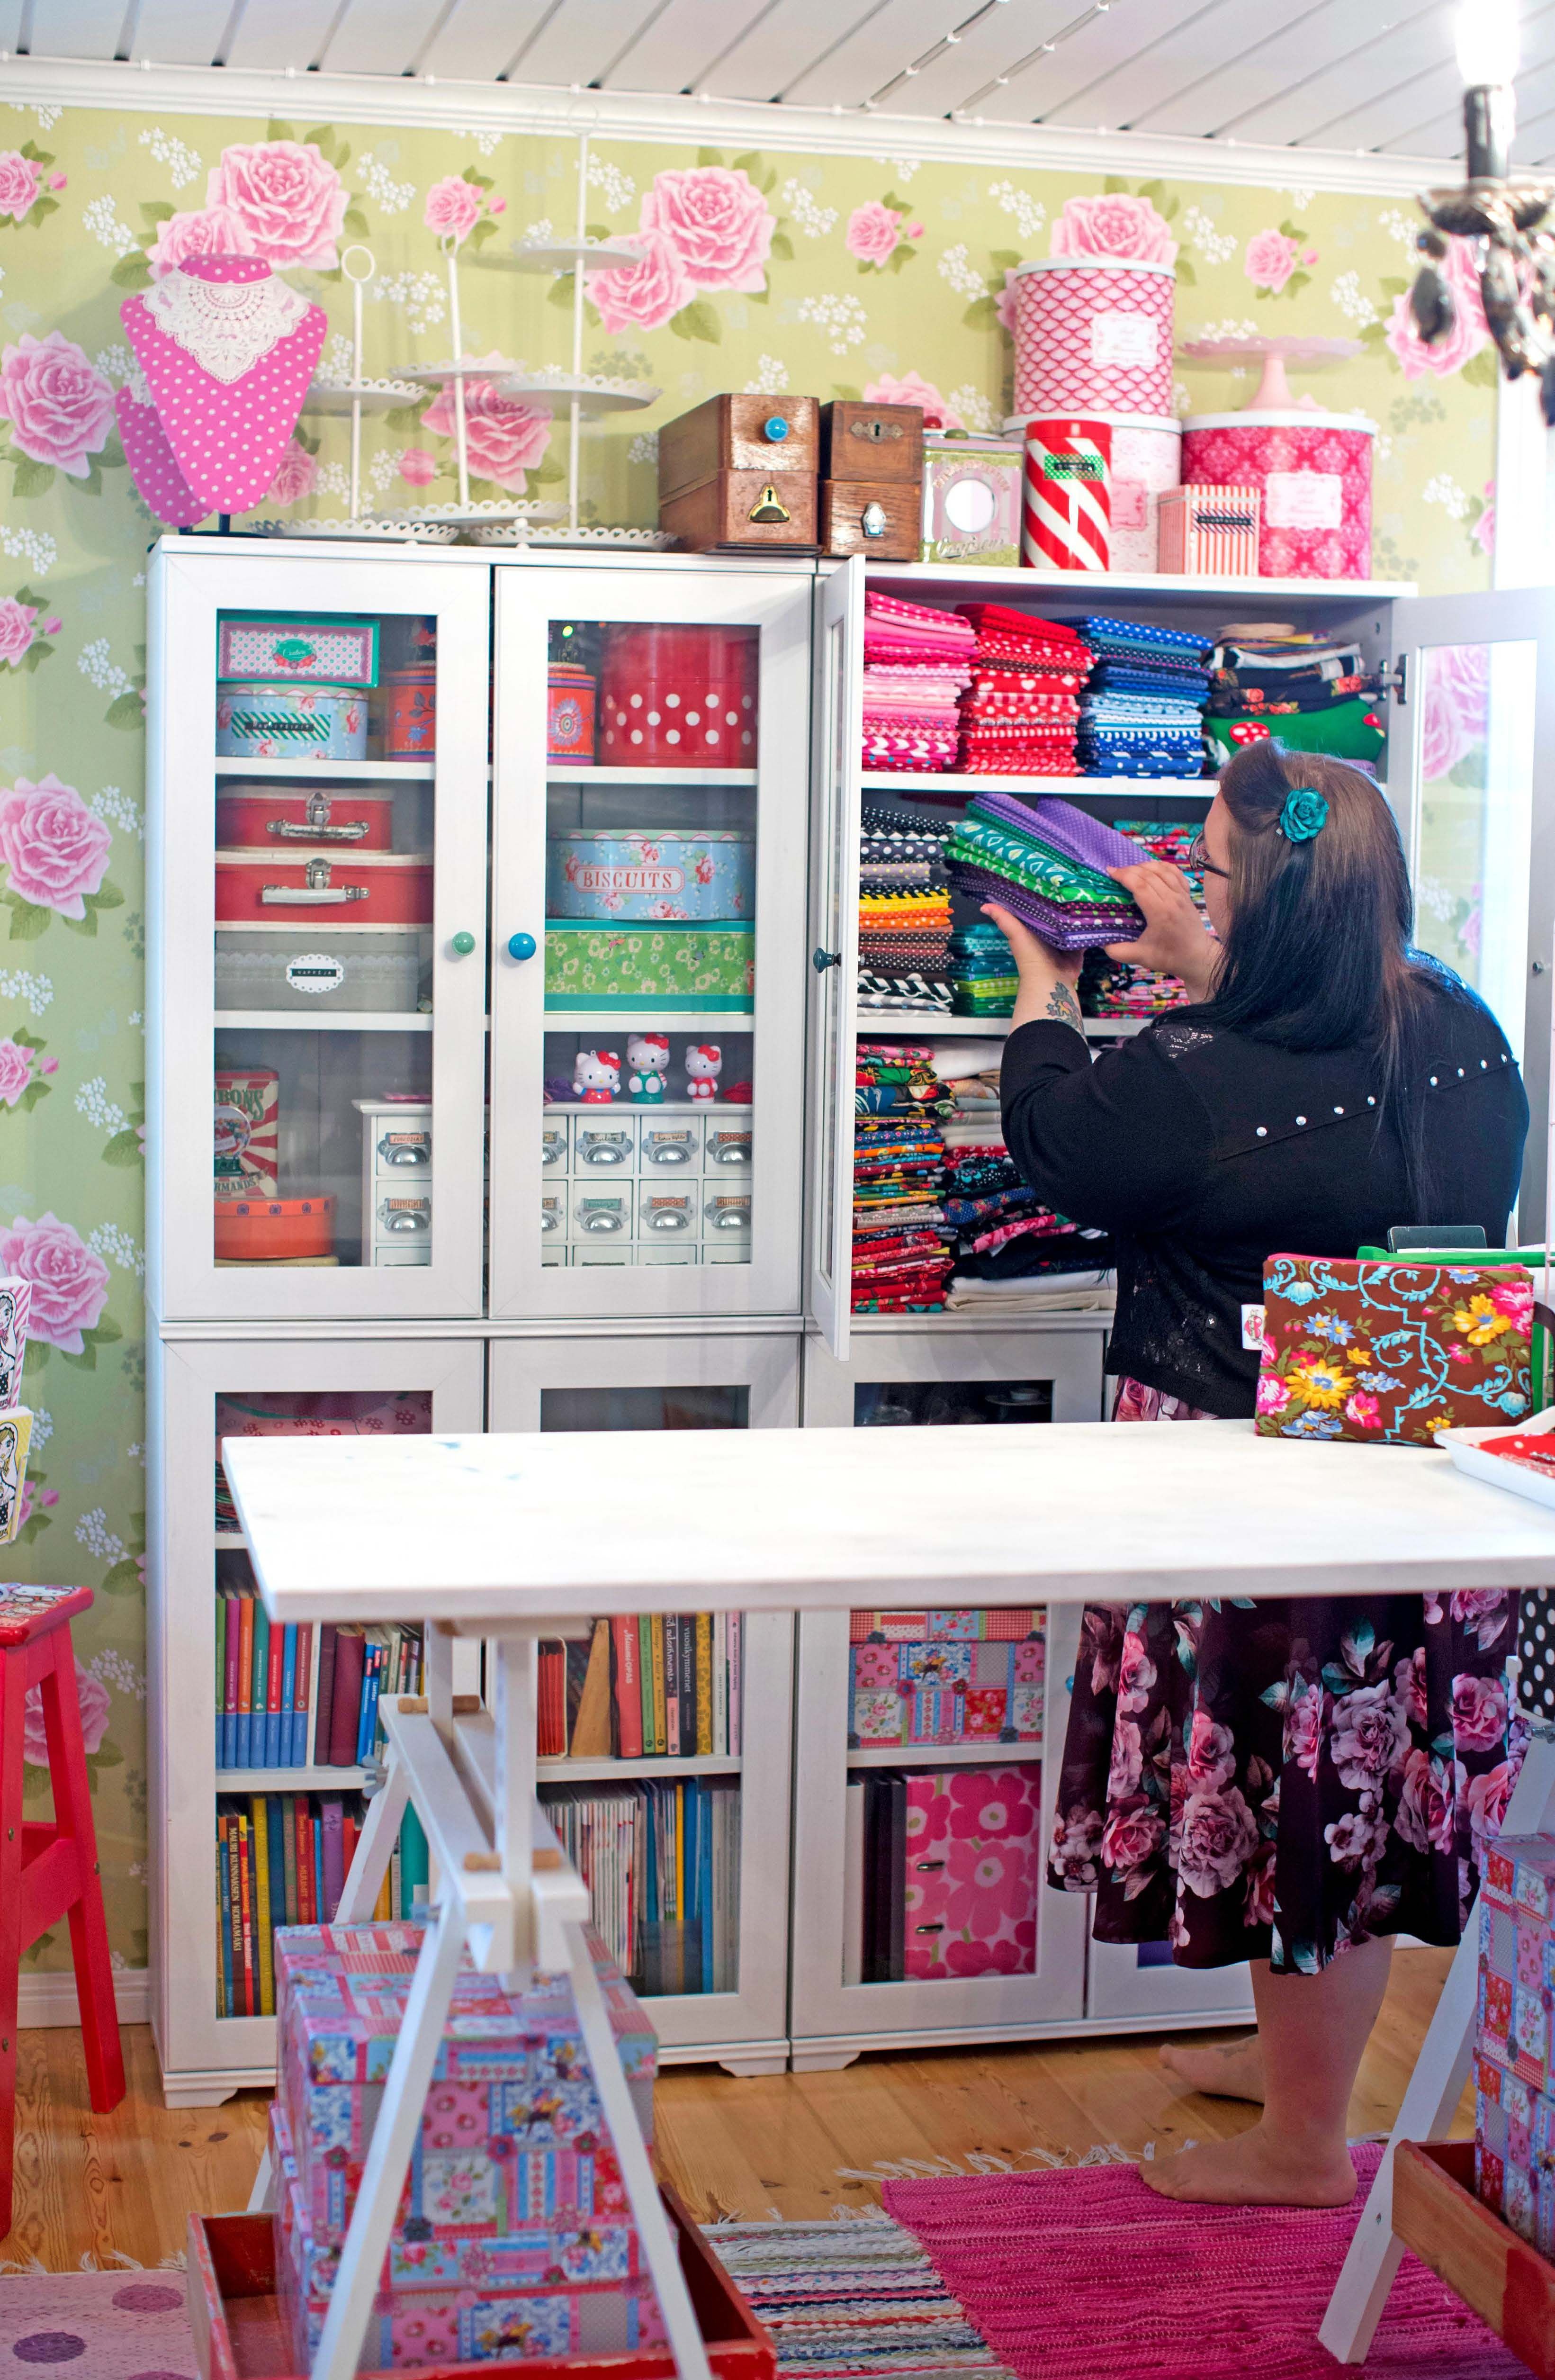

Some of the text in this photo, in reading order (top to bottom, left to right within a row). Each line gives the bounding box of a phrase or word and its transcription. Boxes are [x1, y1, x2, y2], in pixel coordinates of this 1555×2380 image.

[584, 871, 673, 889] BISCUITS
[681, 1627, 692, 1693] vuosikymmenet
[229, 1827, 243, 1951] MAURI KUNNAKSEN KOIRAMÄKI
